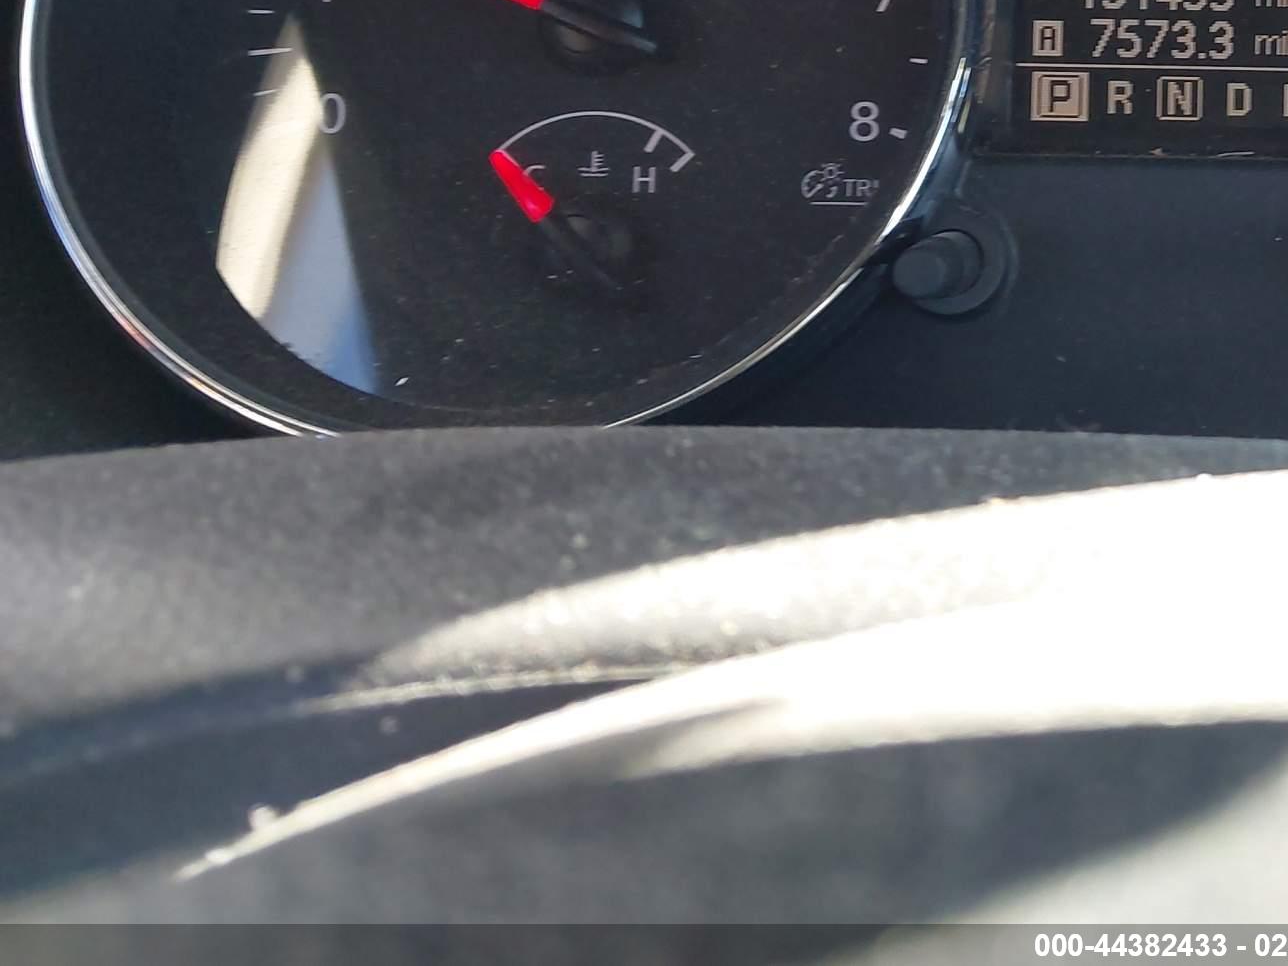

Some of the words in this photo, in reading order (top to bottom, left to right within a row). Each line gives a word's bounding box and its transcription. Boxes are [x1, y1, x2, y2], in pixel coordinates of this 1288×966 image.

[1090, 18, 1234, 60] 7573.3
[318, 92, 346, 134] 0
[1107, 80, 1134, 115] R
[1167, 81, 1193, 116] N
[1226, 82, 1252, 117] D
[849, 101, 880, 142] 8
[632, 166, 657, 194] H
